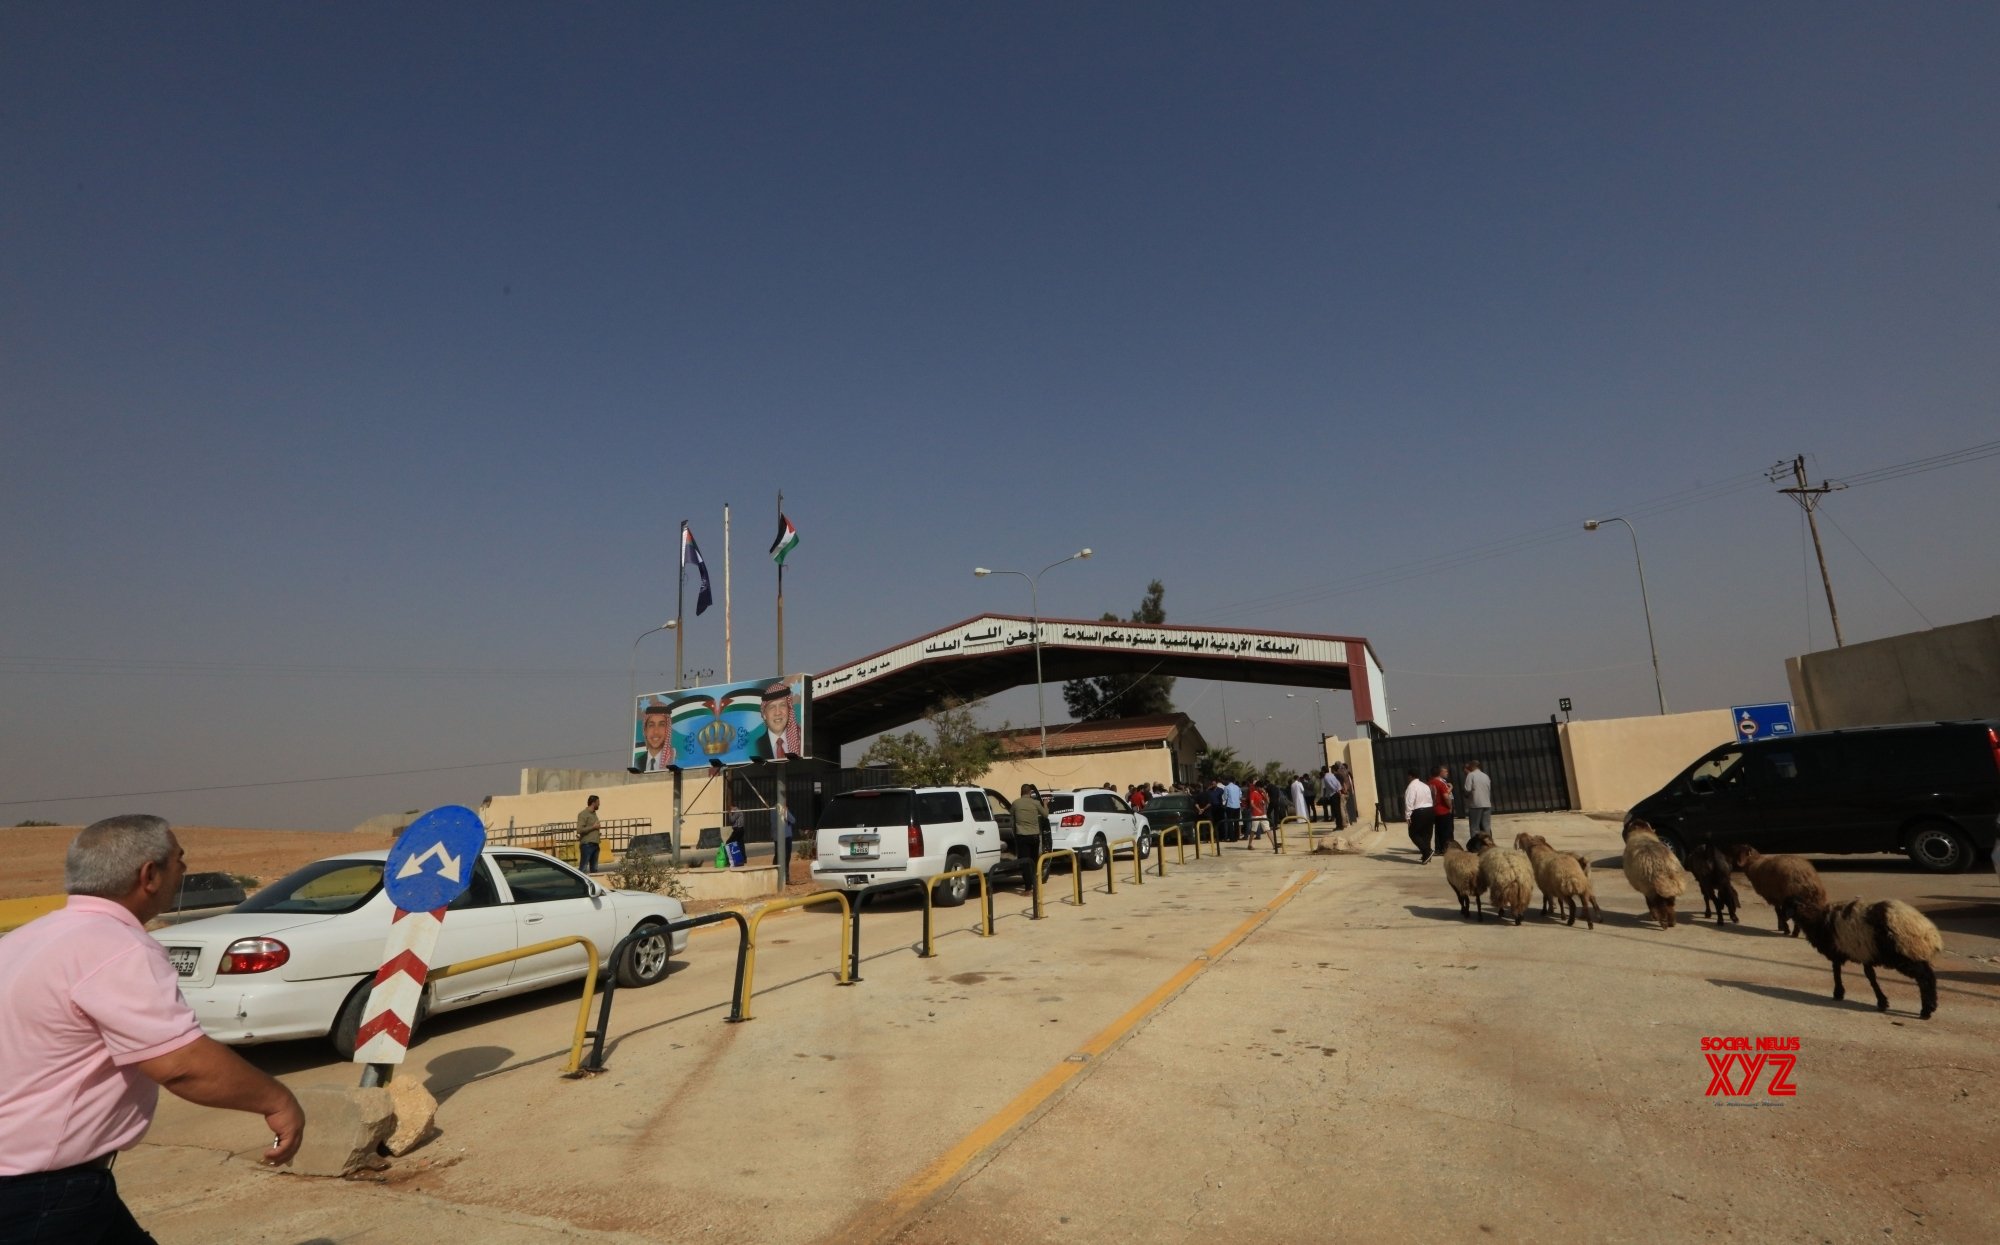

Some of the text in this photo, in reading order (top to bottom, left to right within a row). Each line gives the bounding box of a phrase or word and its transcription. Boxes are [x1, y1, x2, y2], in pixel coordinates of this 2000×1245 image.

[964, 625, 1002, 641] الله
[1063, 627, 1300, 654] المملكة الأردنية الهاشمية تستودعكم السلامة
[925, 639, 960, 653] الملك
[818, 660, 890, 689] مديرية حدود
